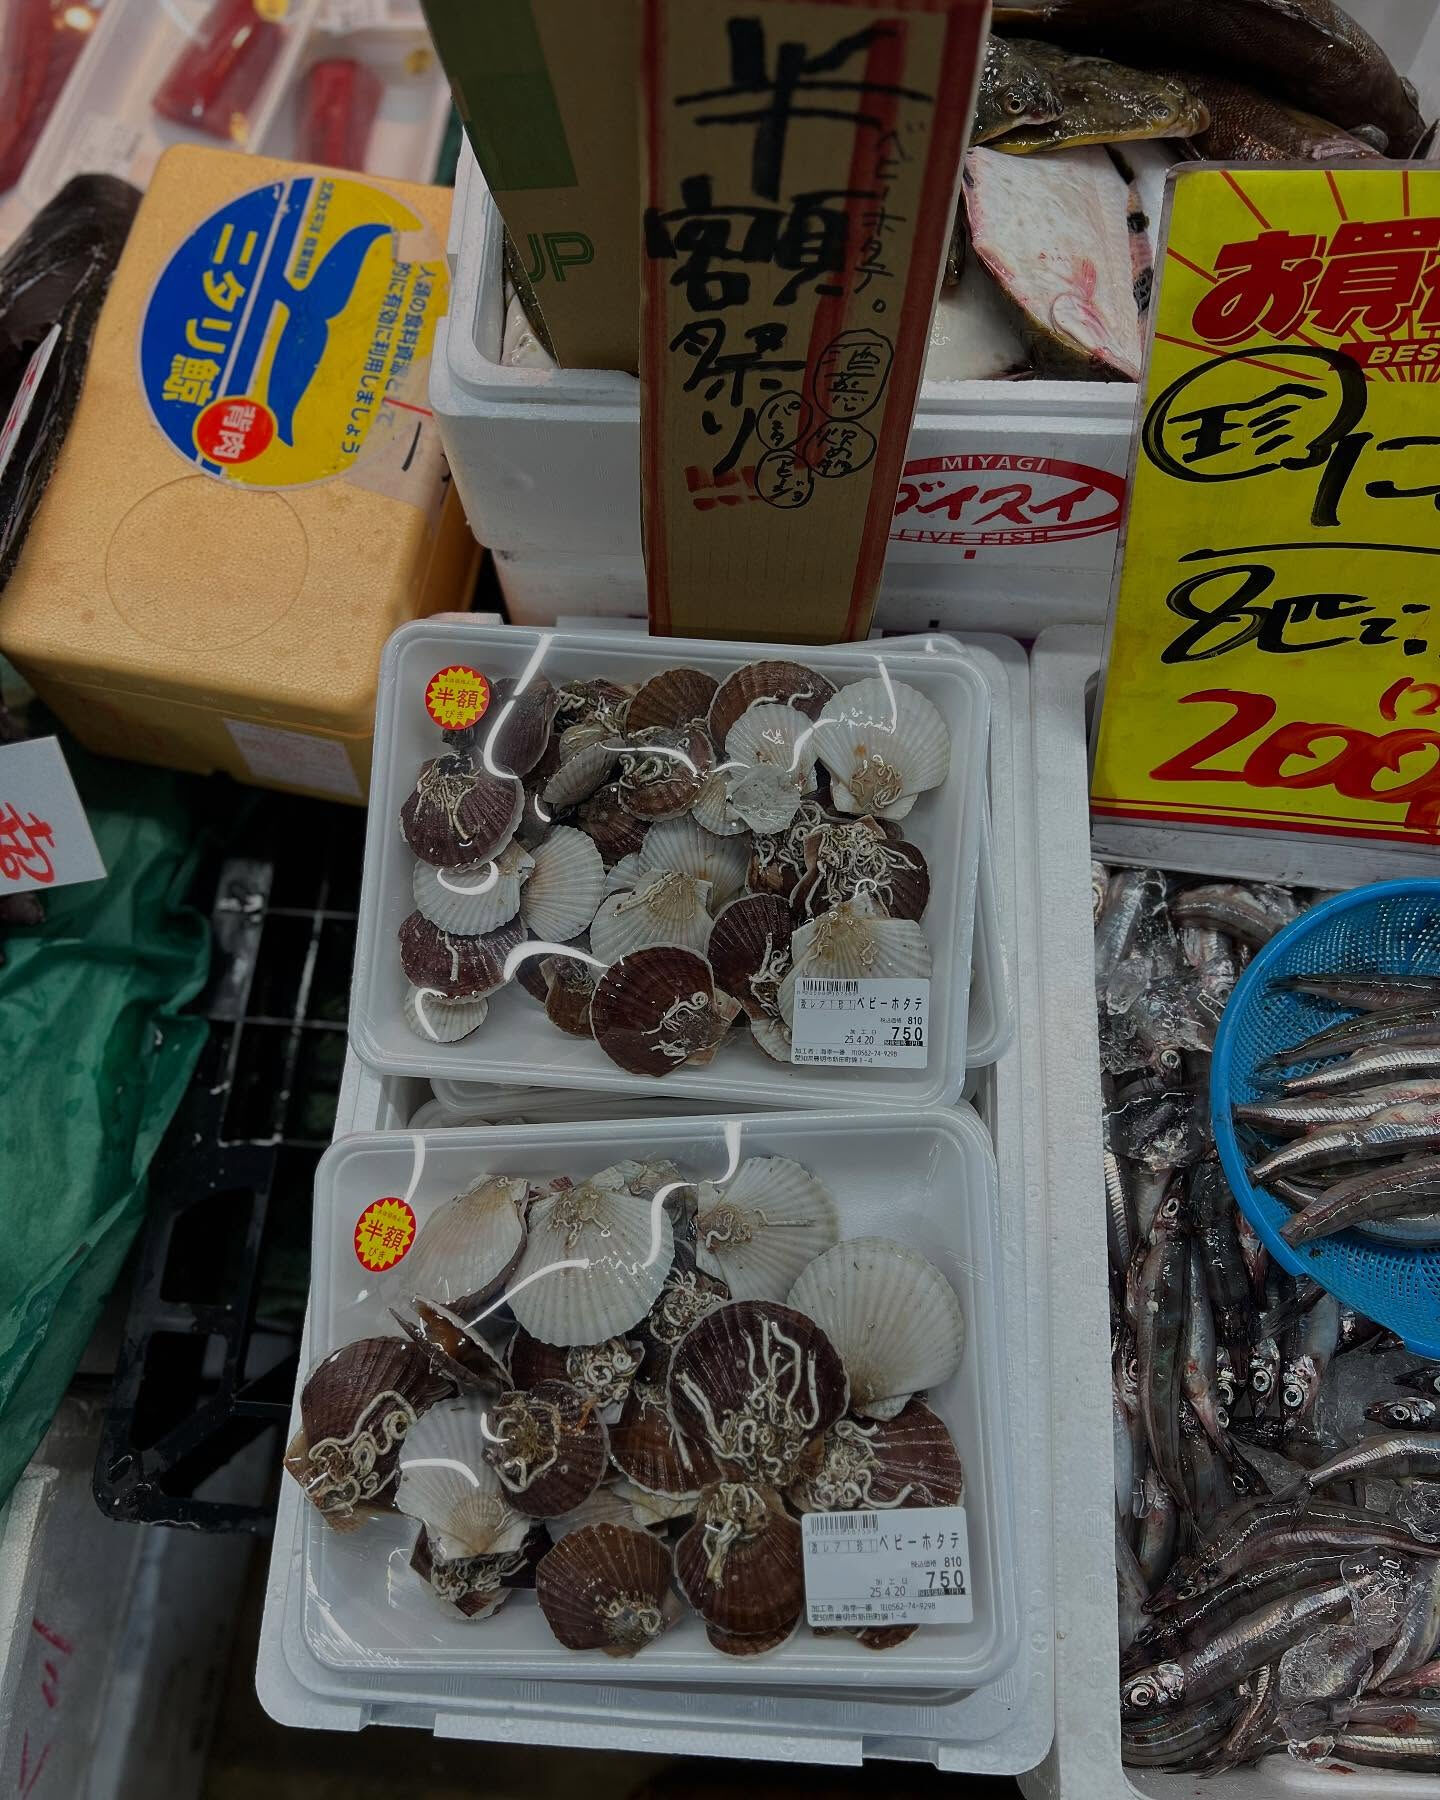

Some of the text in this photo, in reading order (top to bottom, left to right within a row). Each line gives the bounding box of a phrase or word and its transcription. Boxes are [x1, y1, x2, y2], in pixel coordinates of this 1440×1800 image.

[160, 222, 261, 407] ニタリ鯨
[341, 259, 414, 455] 的に有効に利用しましょう
[207, 402, 257, 461] 背肉
[941, 455, 1047, 472] MIYAGI
[899, 528, 1050, 545] LIVE FISH
[435, 687, 479, 709] 半額
[907, 1016, 923, 1026] 810
[891, 1026, 923, 1041] 750
[365, 1219, 406, 1252] 半額
[944, 1556, 962, 1568] 810
[926, 1569, 964, 1589] 750
